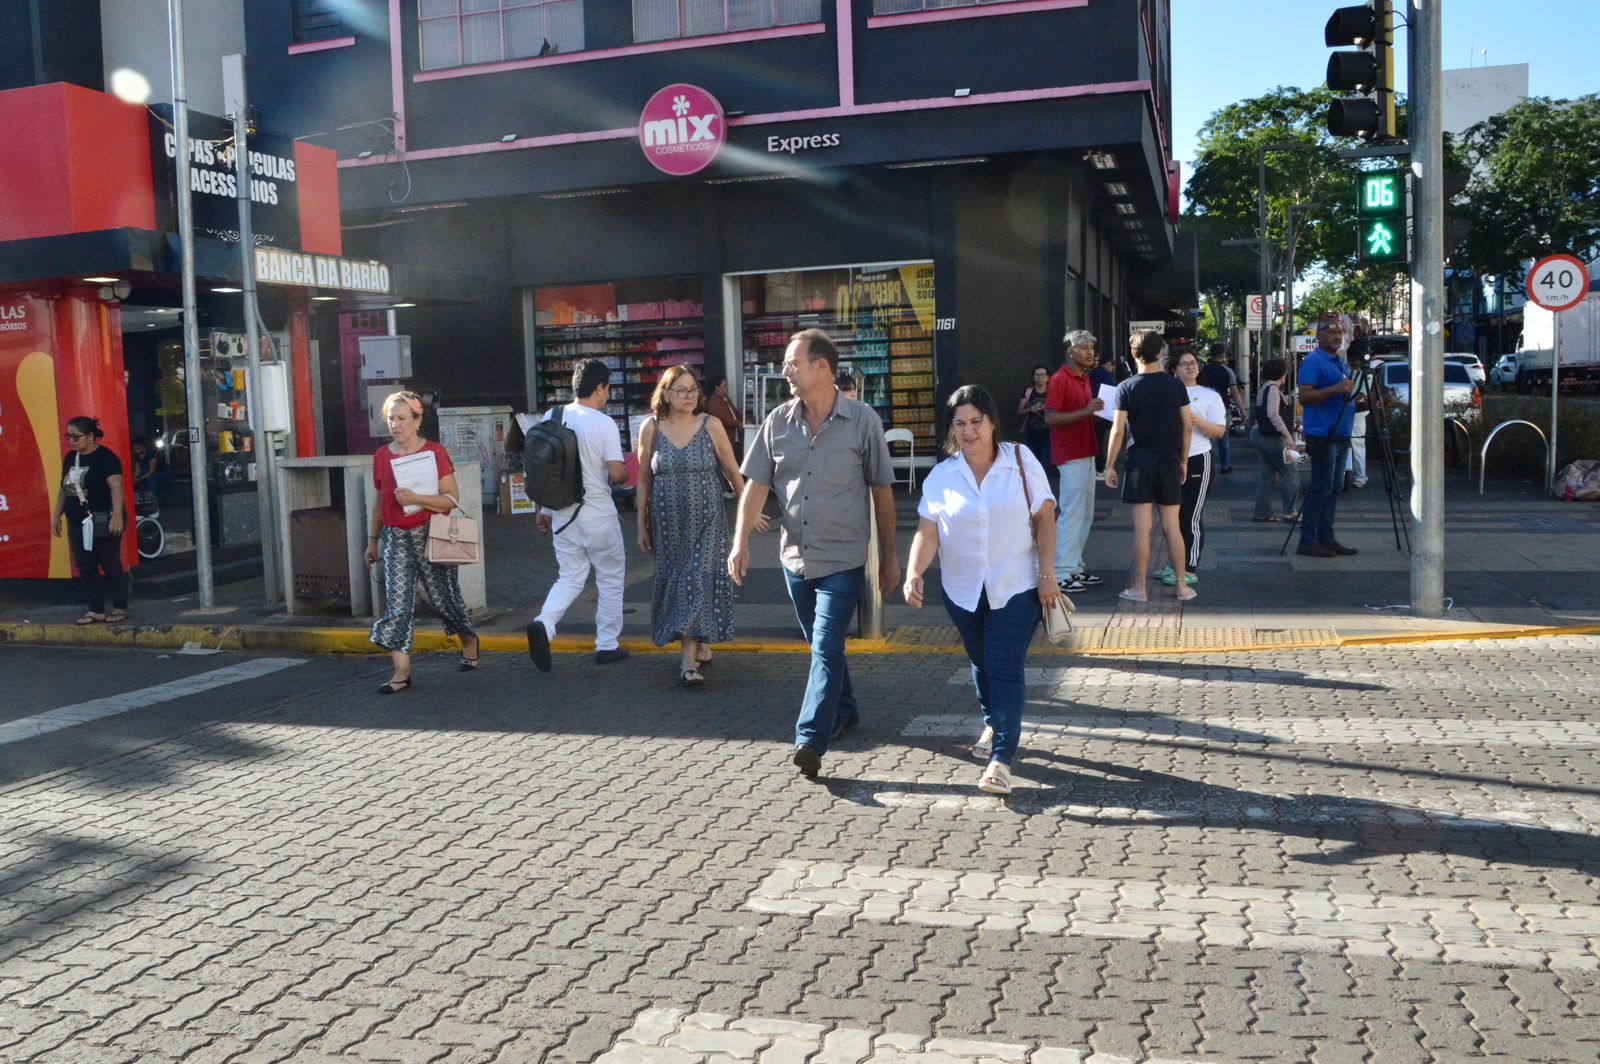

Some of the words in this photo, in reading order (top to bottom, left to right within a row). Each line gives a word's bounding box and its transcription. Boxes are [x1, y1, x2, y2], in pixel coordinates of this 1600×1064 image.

[644, 95, 716, 147] mix
[164, 132, 215, 166] CPAS
[767, 133, 840, 154] Express
[191, 167, 278, 206] ACESSRIOS
[1366, 179, 1394, 207] 06
[255, 249, 315, 285] BANCA
[316, 258, 340, 287] DA
[341, 259, 390, 293] BARÃO
[1540, 270, 1573, 289] 40
[0, 321, 28, 331] SÓRIOS
[936, 318, 956, 331] 1161
